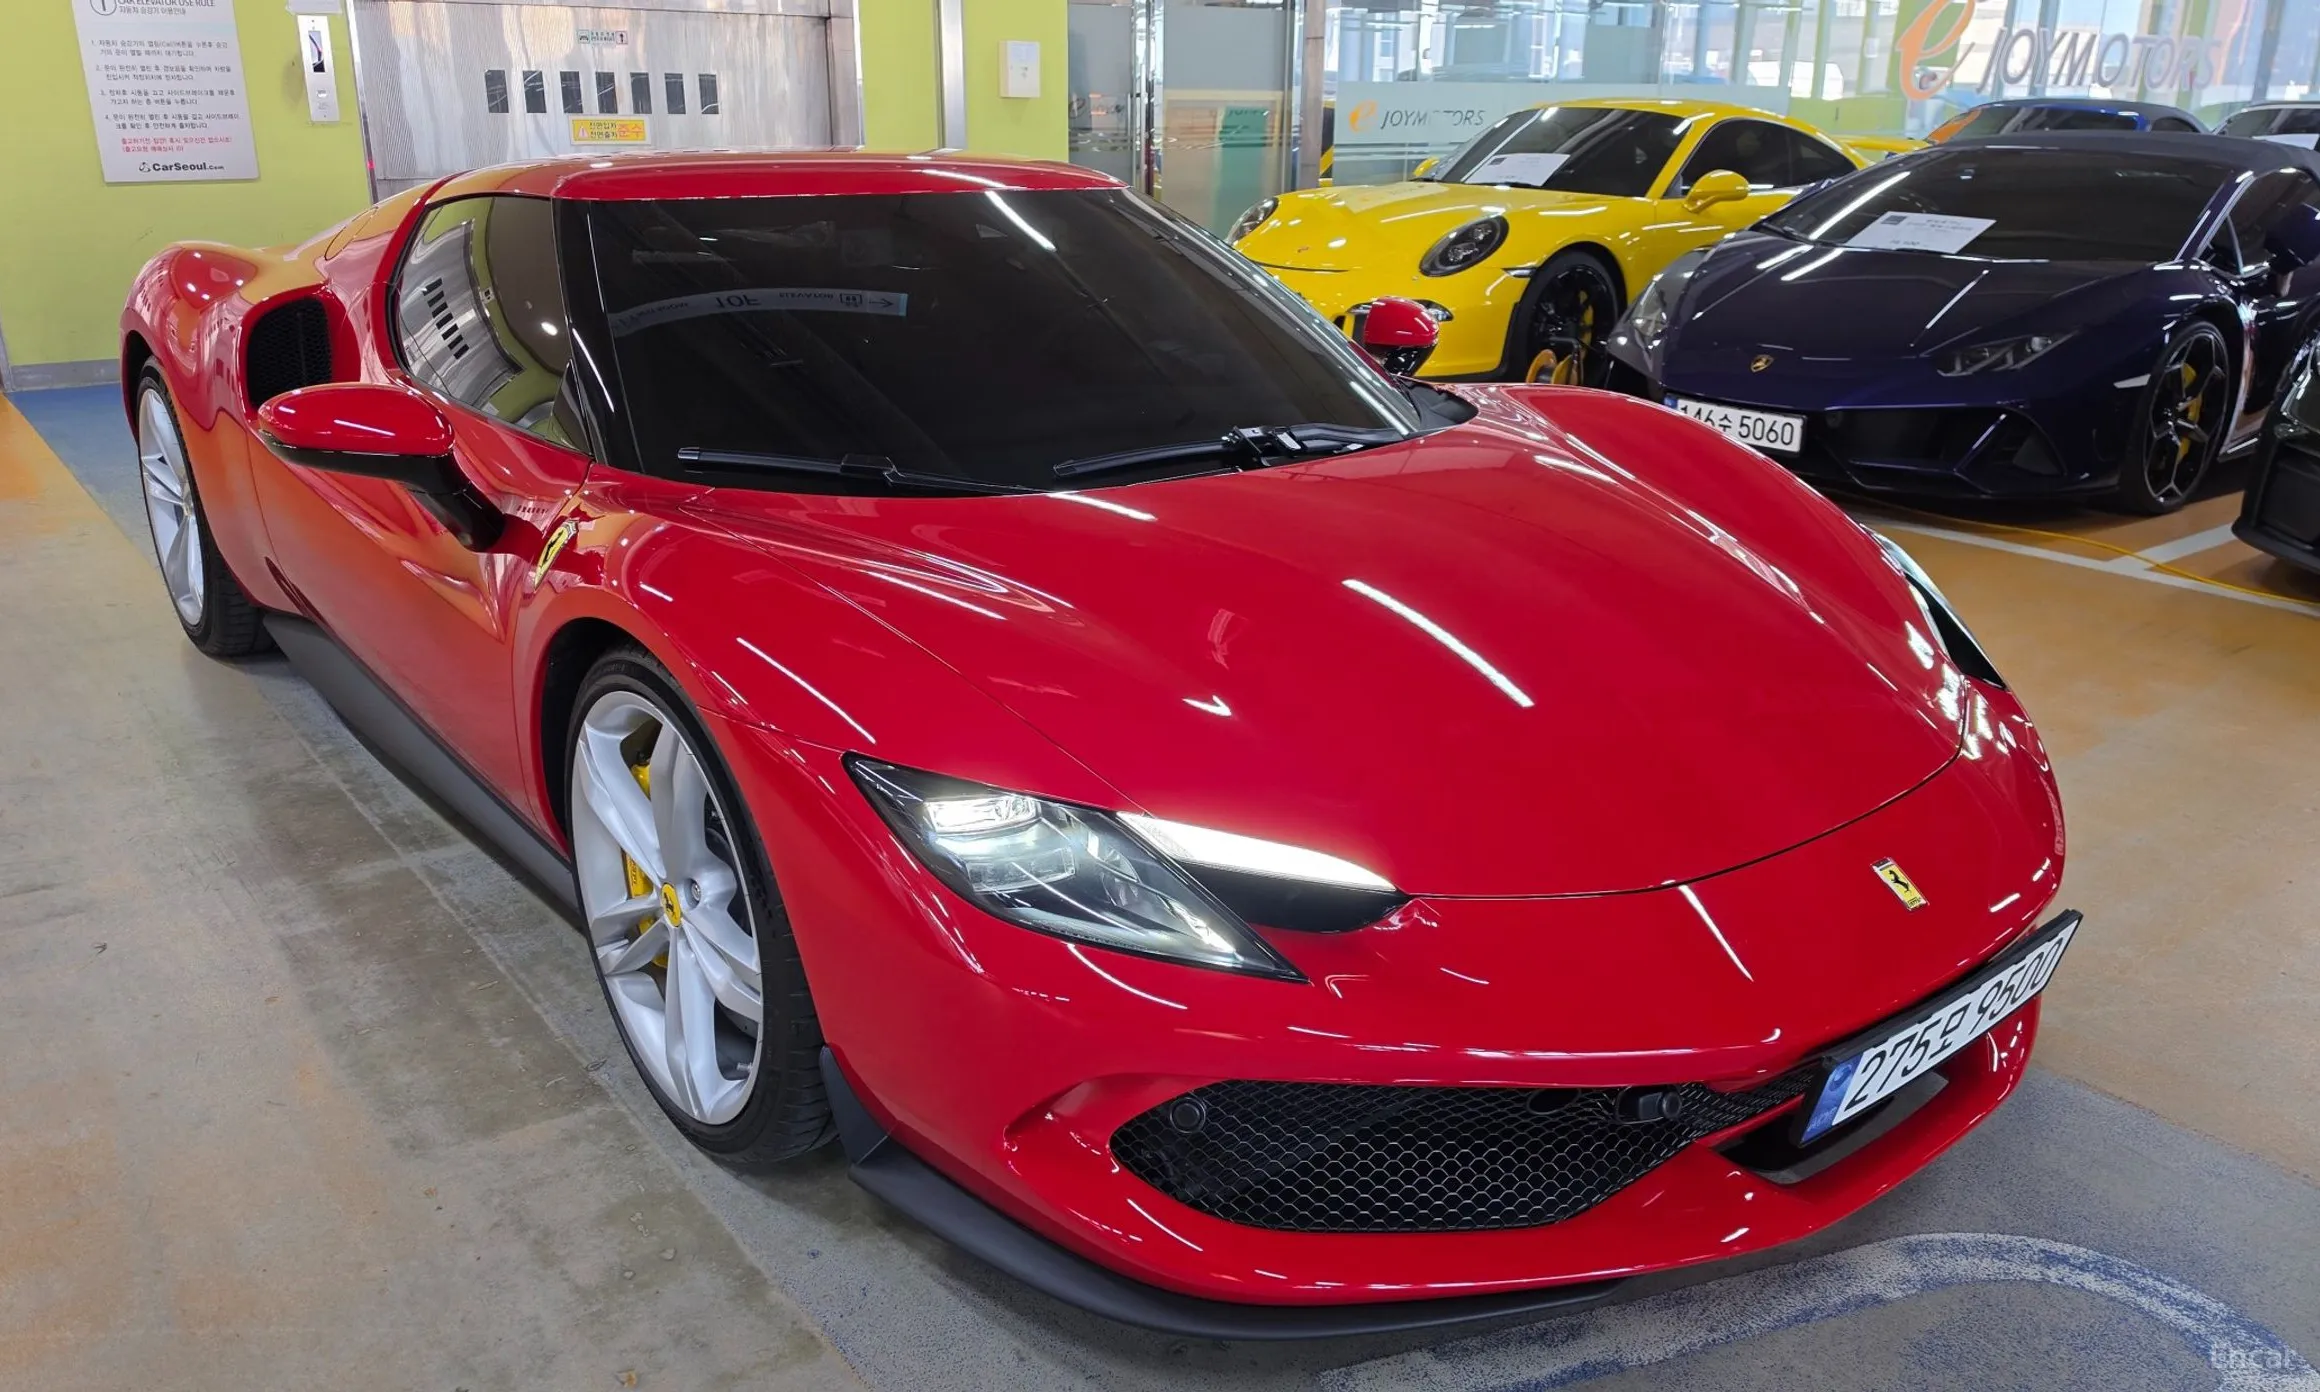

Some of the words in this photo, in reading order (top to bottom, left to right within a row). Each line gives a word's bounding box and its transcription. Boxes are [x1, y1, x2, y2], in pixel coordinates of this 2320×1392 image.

[1977, 25, 2223, 93] JOYMOTORS
[618, 123, 643, 138] 준수
[1380, 110, 1486, 130] JOYMORS
[1738, 415, 1795, 446] 5060
[1844, 1002, 1971, 1112] 275모
[1969, 937, 2064, 1036] 9500
